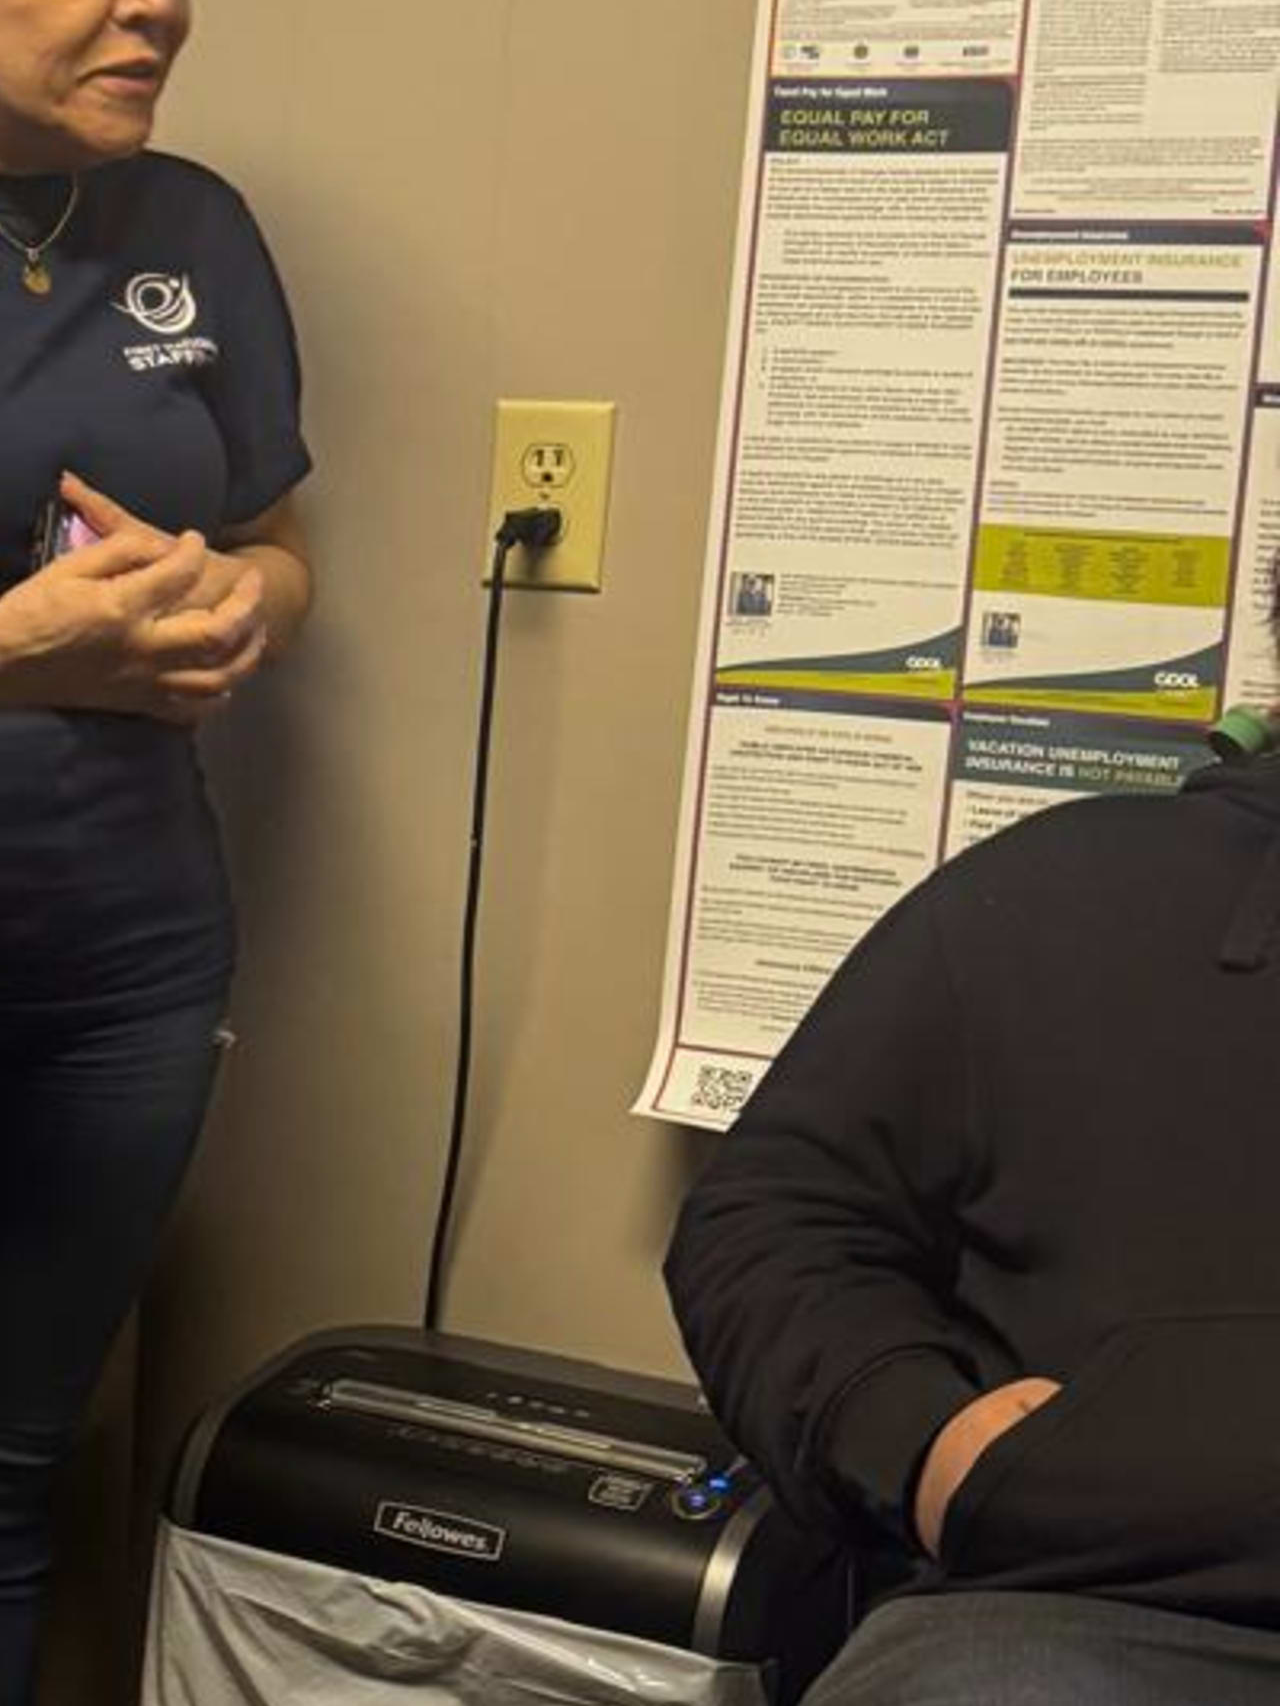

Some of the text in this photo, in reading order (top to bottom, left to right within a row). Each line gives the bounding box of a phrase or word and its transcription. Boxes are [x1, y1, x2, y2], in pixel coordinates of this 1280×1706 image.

[780, 109, 929, 125] EQUAL PAY FOR
[779, 129, 949, 146] EQUAL WORK ACT
[1011, 269, 1144, 284] FOR EMPLOYEES
[968, 740, 1180, 771] VACATION UNEMPLOYMENT
[965, 756, 1057, 777] INSURANCE
[1059, 764, 1075, 778] IS
[1077, 766, 1110, 781] NOT
[392, 1510, 489, 1551] Fellowes
